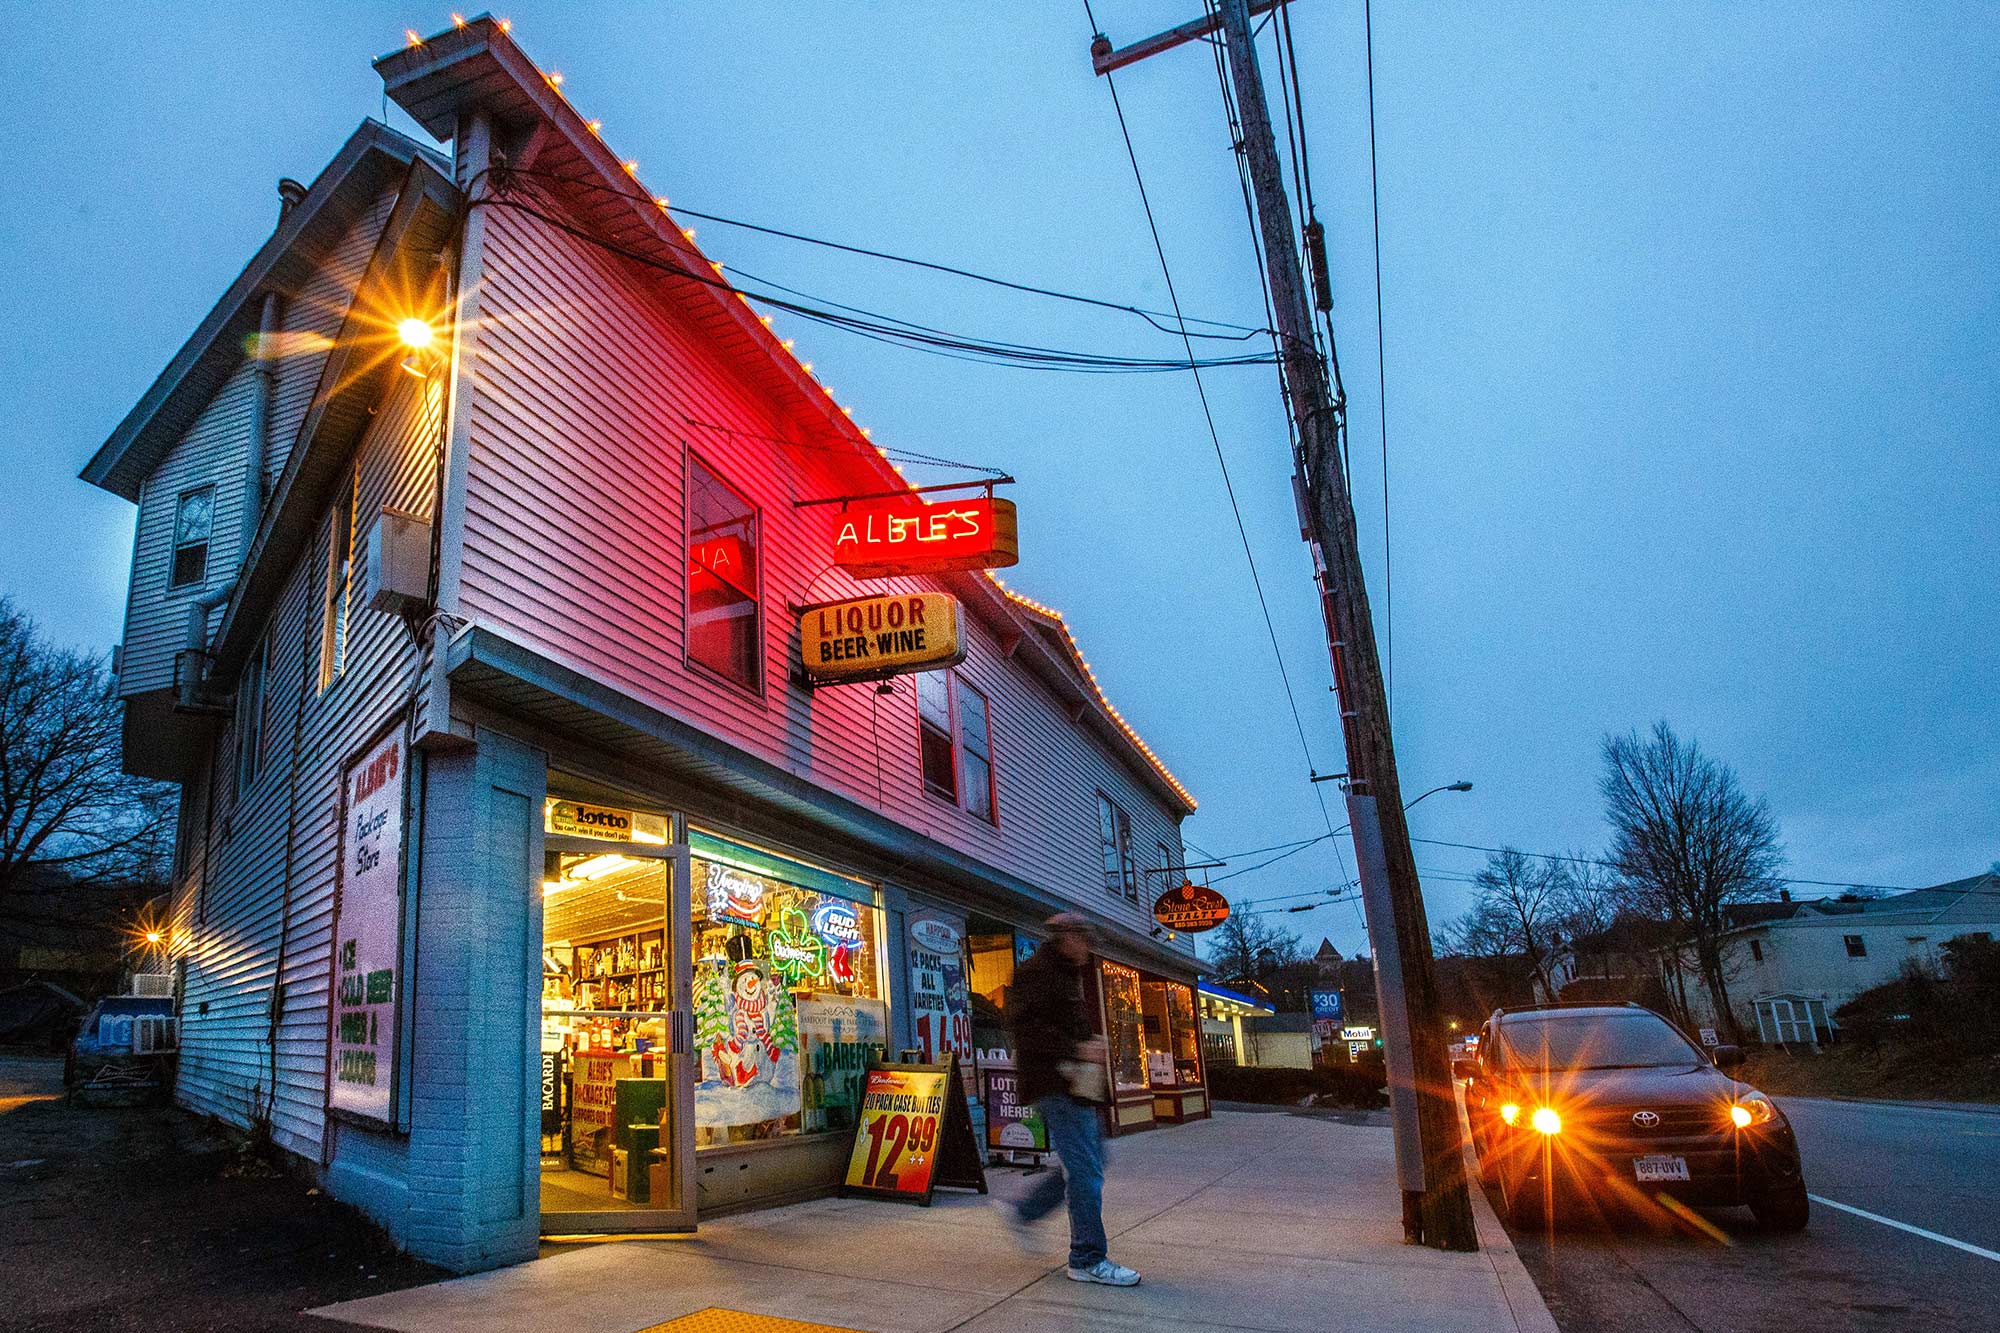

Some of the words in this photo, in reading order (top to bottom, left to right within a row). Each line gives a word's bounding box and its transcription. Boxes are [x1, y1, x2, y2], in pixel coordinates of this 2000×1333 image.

[818, 598, 927, 639] LIQUOR
[820, 635, 869, 663] BEER
[876, 628, 927, 654] WINE
[354, 806, 389, 844] Package
[576, 807, 629, 830] lotto
[554, 823, 564, 832] You
[564, 825, 577, 833] can't
[594, 829, 604, 838] you
[604, 830, 618, 839] don't
[355, 844, 380, 877] Store
[708, 864, 763, 903] Yuengling
[1159, 898, 1191, 914] Stone
[1192, 895, 1224, 911] Crest
[829, 912, 856, 928] BUD
[1167, 910, 1217, 921] REALTY
[823, 922, 861, 941] LIGHT
[773, 940, 816, 964] Budweiser
[912, 950, 918, 968] 12
[920, 952, 942, 972] PACKS
[922, 972, 936, 990] ALL
[914, 991, 944, 1011] VARIETIES
[1313, 994, 1338, 1007] $30
[1343, 1030, 1370, 1038] Mobil
[823, 1042, 885, 1071] BAREFO
[542, 1054, 554, 1110] BACARDI
[991, 1077, 1017, 1092] LOTT
[865, 1093, 875, 1110] 20
[875, 1093, 894, 1111] PACK
[894, 1094, 913, 1112] CASE
[912, 1095, 942, 1114] BOTTLES
[1002, 1092, 1018, 1105] SO
[1000, 1105, 1033, 1119] HERE!
